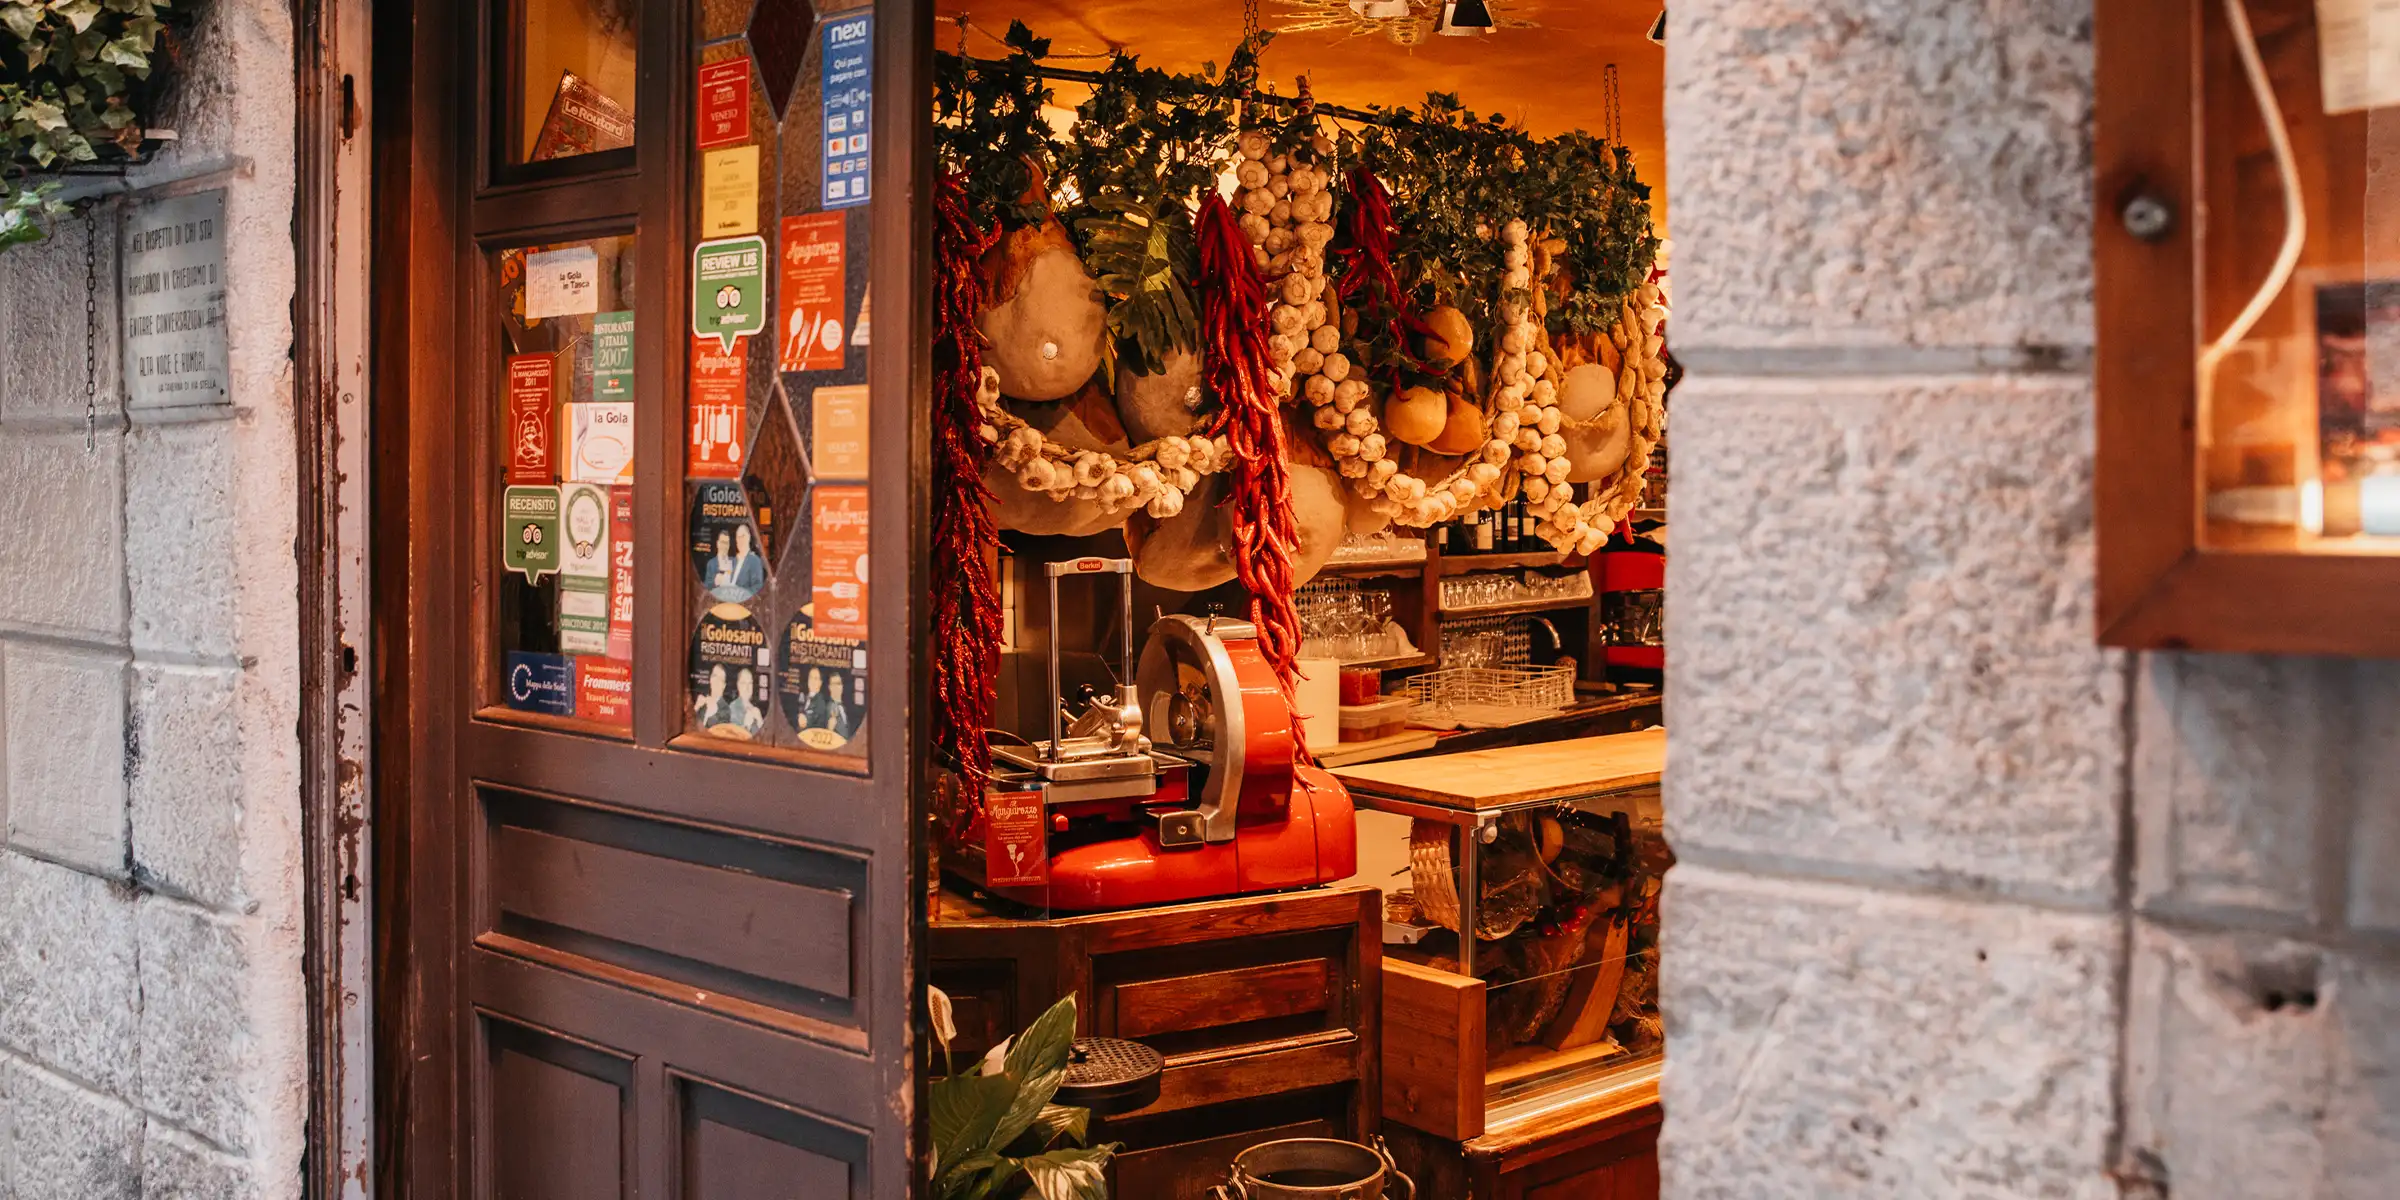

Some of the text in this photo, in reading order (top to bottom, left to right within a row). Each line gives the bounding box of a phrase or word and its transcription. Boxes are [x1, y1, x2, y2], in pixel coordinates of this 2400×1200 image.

[831, 21, 866, 43] nexi
[834, 57, 848, 70] Qui
[565, 101, 624, 136] Le Routard
[711, 108, 738, 121] VENETO
[133, 218, 213, 253] NEL RISPETTO DI CHI STA
[702, 252, 758, 271] REVIEW US
[129, 263, 217, 296] RIPOSANDO VI CHIEDIAMO DI
[560, 270, 582, 281] la Gola
[570, 280, 590, 290] Tasca
[129, 315, 153, 338] EVITARE
[156, 308, 205, 334] CONVERSAZIONI
[594, 321, 634, 335] RISTORANTI
[139, 356, 154, 377] ALTA
[156, 353, 171, 375] VOCE
[174, 353, 180, 374] E
[599, 347, 629, 368] 2007
[595, 411, 628, 424] la Gola
[509, 498, 556, 511] RECENSITO
[614, 540, 624, 621] MAGNAR
[701, 641, 752, 657] RISTORANTI
[790, 641, 851, 660] RISTORANTI
[811, 731, 832, 745] 2022
